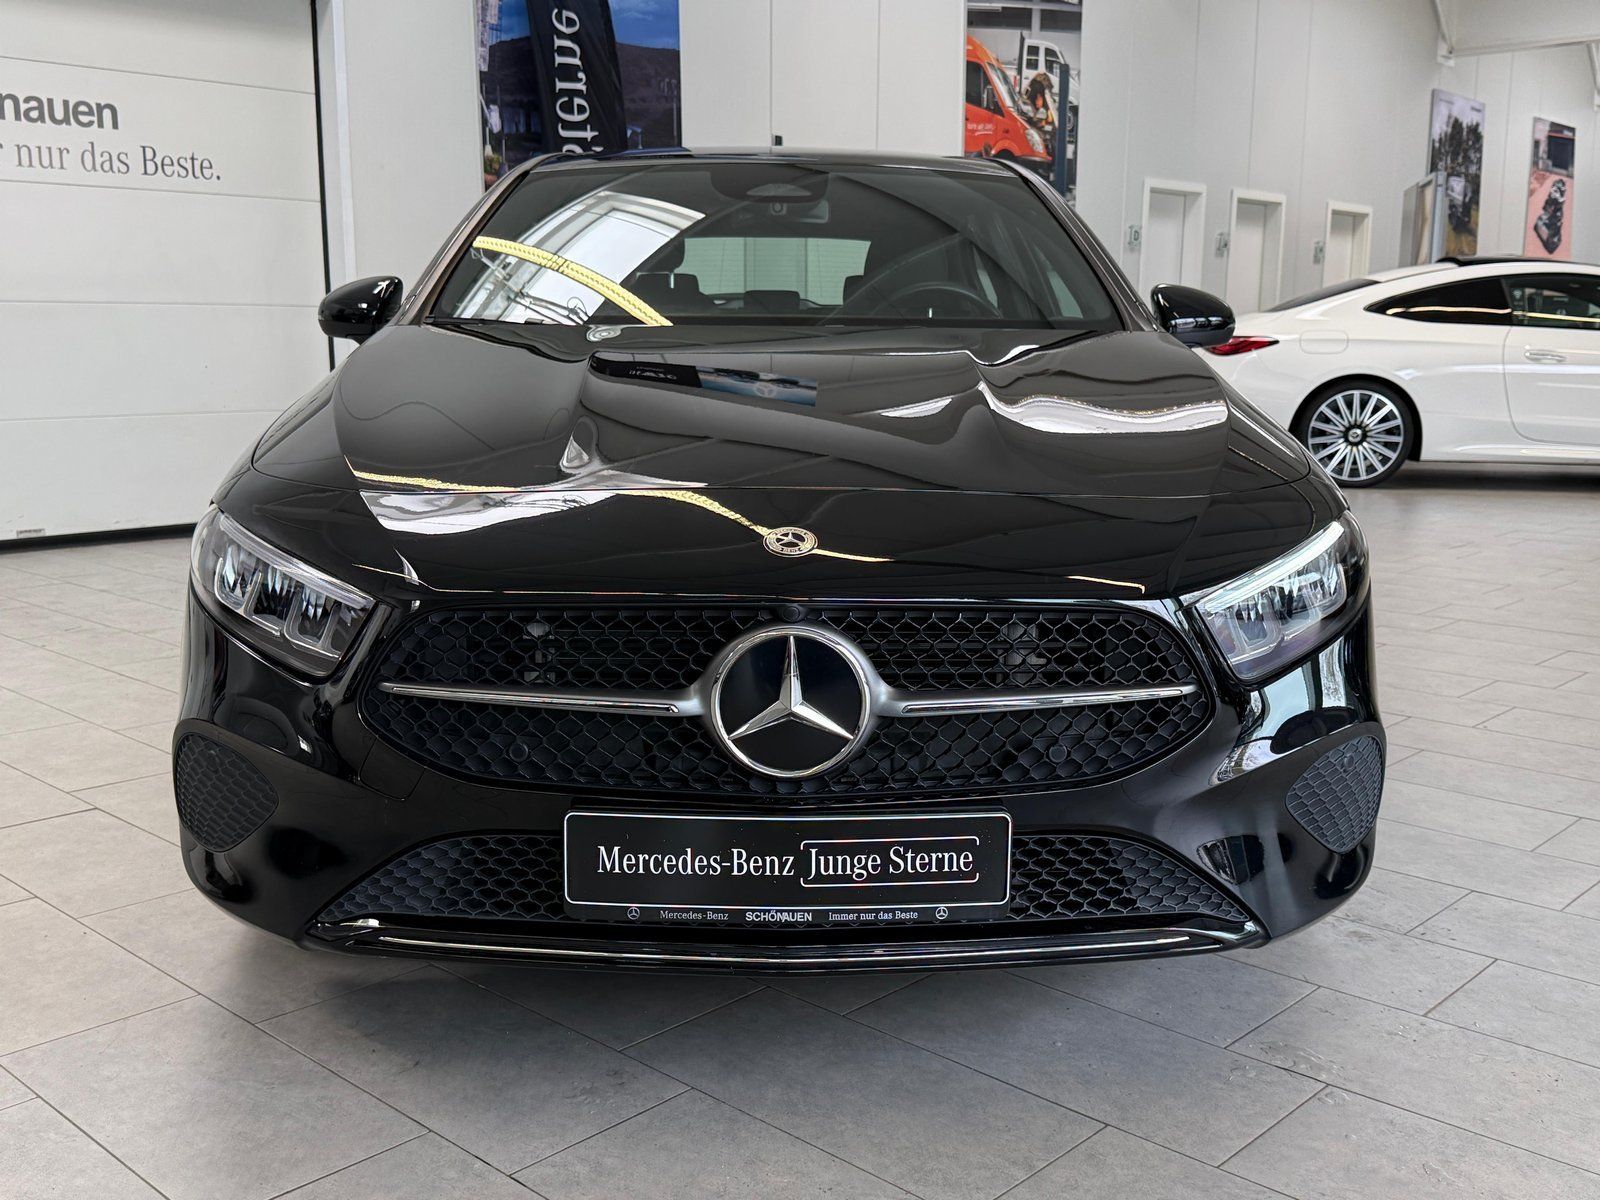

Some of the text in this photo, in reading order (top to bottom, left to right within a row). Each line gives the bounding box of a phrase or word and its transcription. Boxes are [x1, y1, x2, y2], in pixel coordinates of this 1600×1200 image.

[551, 7, 605, 153] terne
[0, 93, 119, 130] nauen
[15, 141, 221, 181] nur das Beste.
[597, 845, 974, 881] Mercedes-Benz Junge Sterne
[659, 910, 729, 921] Mercedes-Benz
[828, 912, 859, 921] Immer
[860, 912, 877, 921] nur
[877, 911, 893, 920] das
[895, 910, 919, 920] Beste
